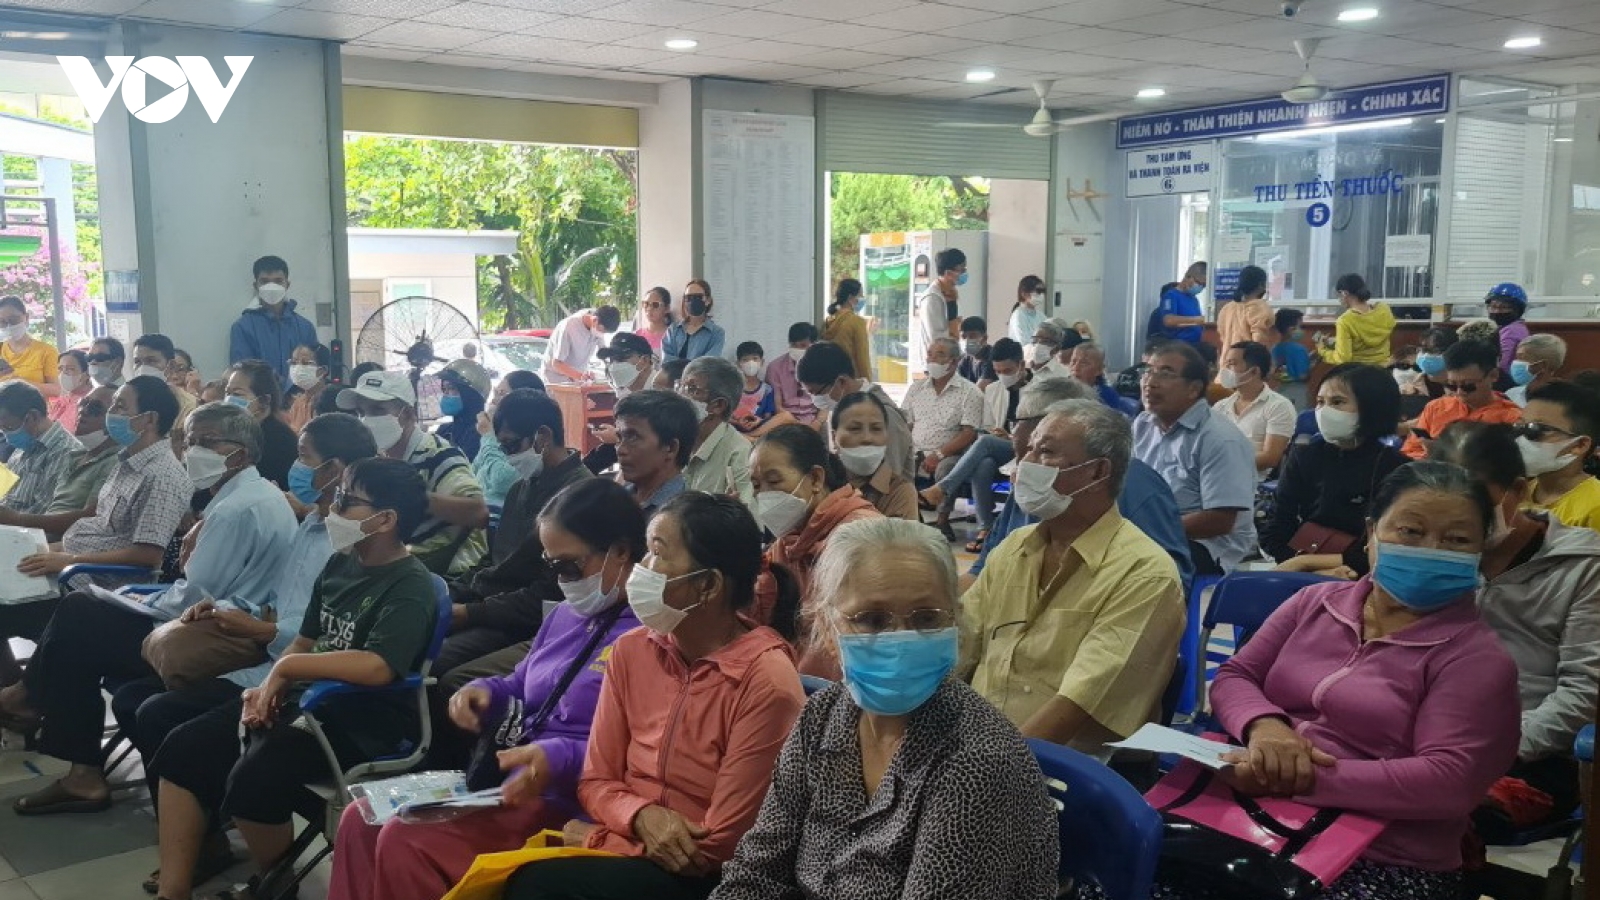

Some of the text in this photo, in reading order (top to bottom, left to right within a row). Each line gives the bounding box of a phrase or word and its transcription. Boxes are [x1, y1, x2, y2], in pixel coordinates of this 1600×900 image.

[1218, 111, 1254, 129] THIỆN
[1257, 105, 1305, 124] NHANH
[1308, 100, 1347, 119] NHẸN
[1361, 90, 1407, 111] CHÍNH
[1411, 85, 1441, 105] XÁC
[1254, 169, 1404, 203] THU TIỀN THUỐC
[1313, 206, 1325, 223] 5
